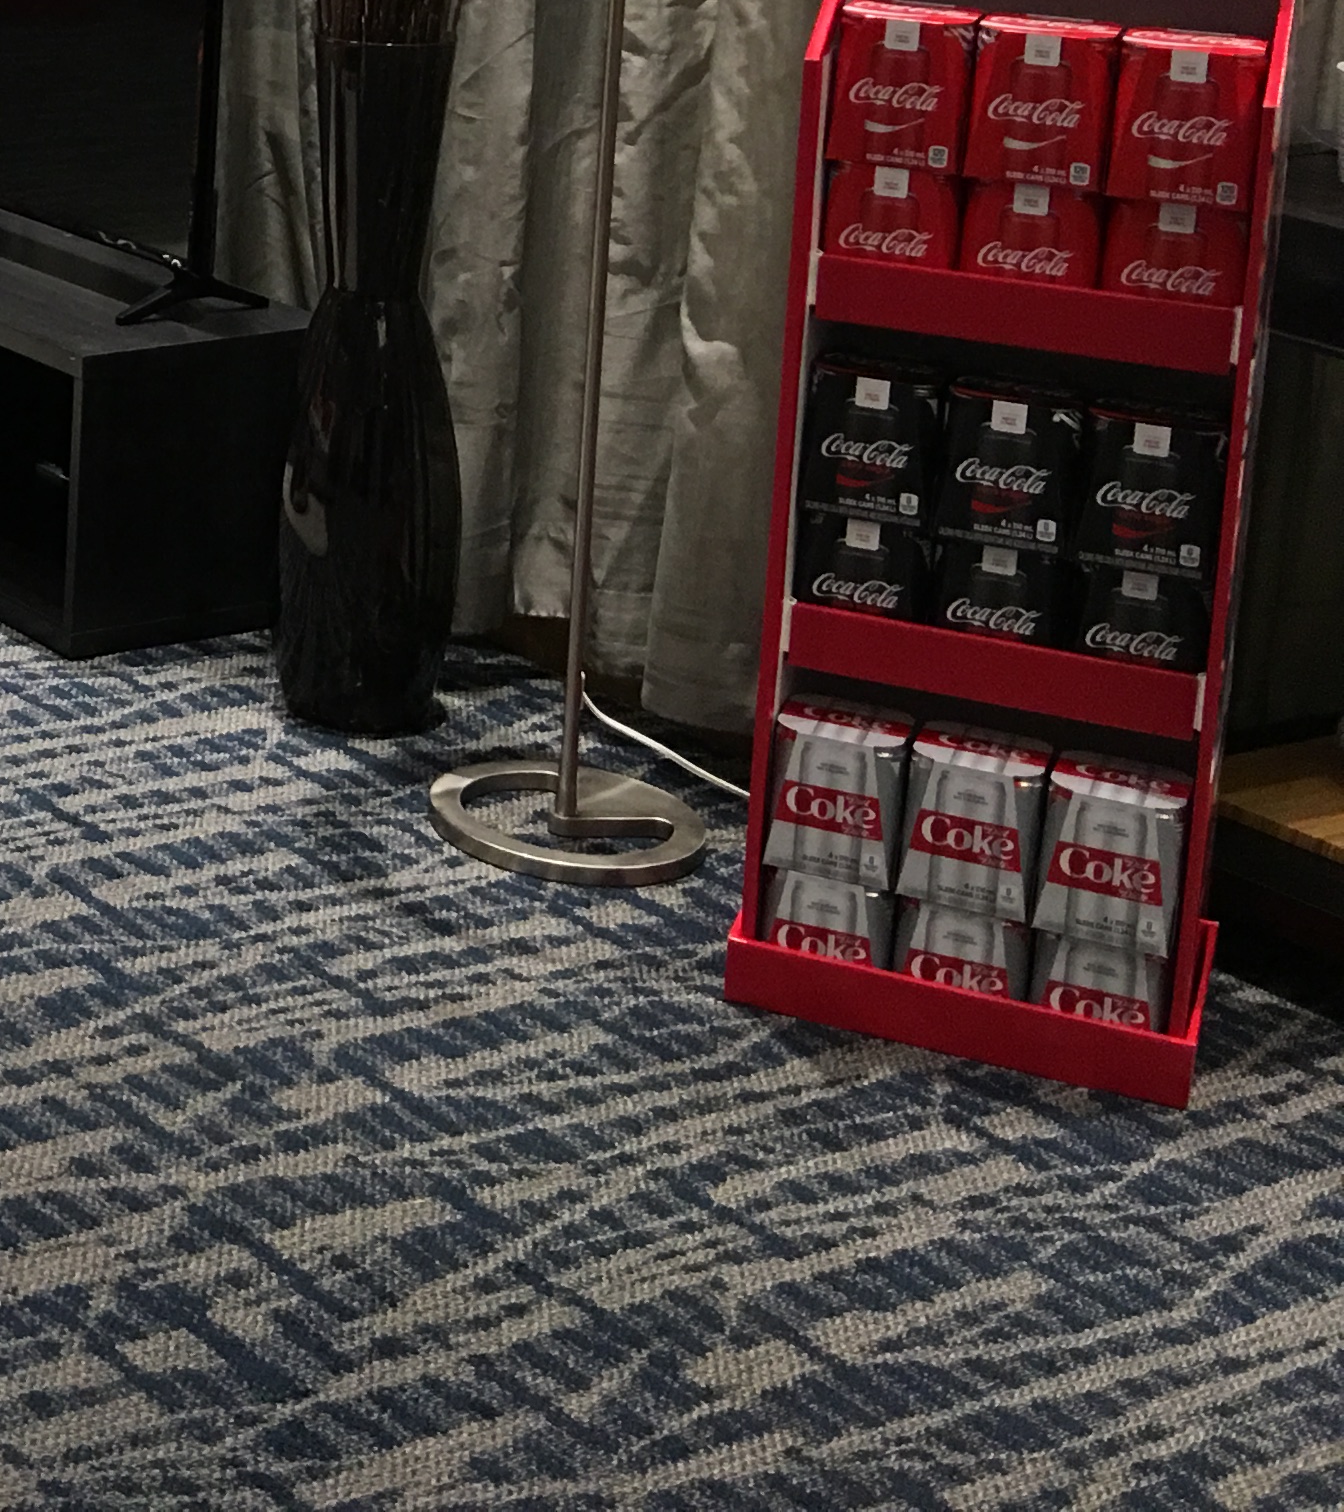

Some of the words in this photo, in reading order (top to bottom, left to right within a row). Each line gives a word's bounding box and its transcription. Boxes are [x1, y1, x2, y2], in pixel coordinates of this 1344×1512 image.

[848, 76, 945, 113] Coca-Cola
[987, 93, 1086, 129] Coca-Cola
[1131, 110, 1235, 147] Coca-Cola
[838, 223, 935, 258] Coca-Cola
[976, 240, 1076, 278] Coca-Cola
[1120, 259, 1224, 296] Coca-Cola
[820, 432, 915, 469] Coca-Cola
[955, 457, 1054, 495] Coca-Cola
[1095, 481, 1197, 520] Coca-Cola
[812, 571, 905, 609] Coca-Cola
[945, 596, 1045, 637] Coca-Cola
[1084, 622, 1185, 662] Coca-Cola
[785, 784, 877, 830] Coke
[920, 814, 1015, 861] Coke
[1058, 847, 1157, 894] Coke
[776, 922, 869, 965] Coke
[909, 952, 1004, 997] Coke
[1048, 985, 1146, 1028] Coke
